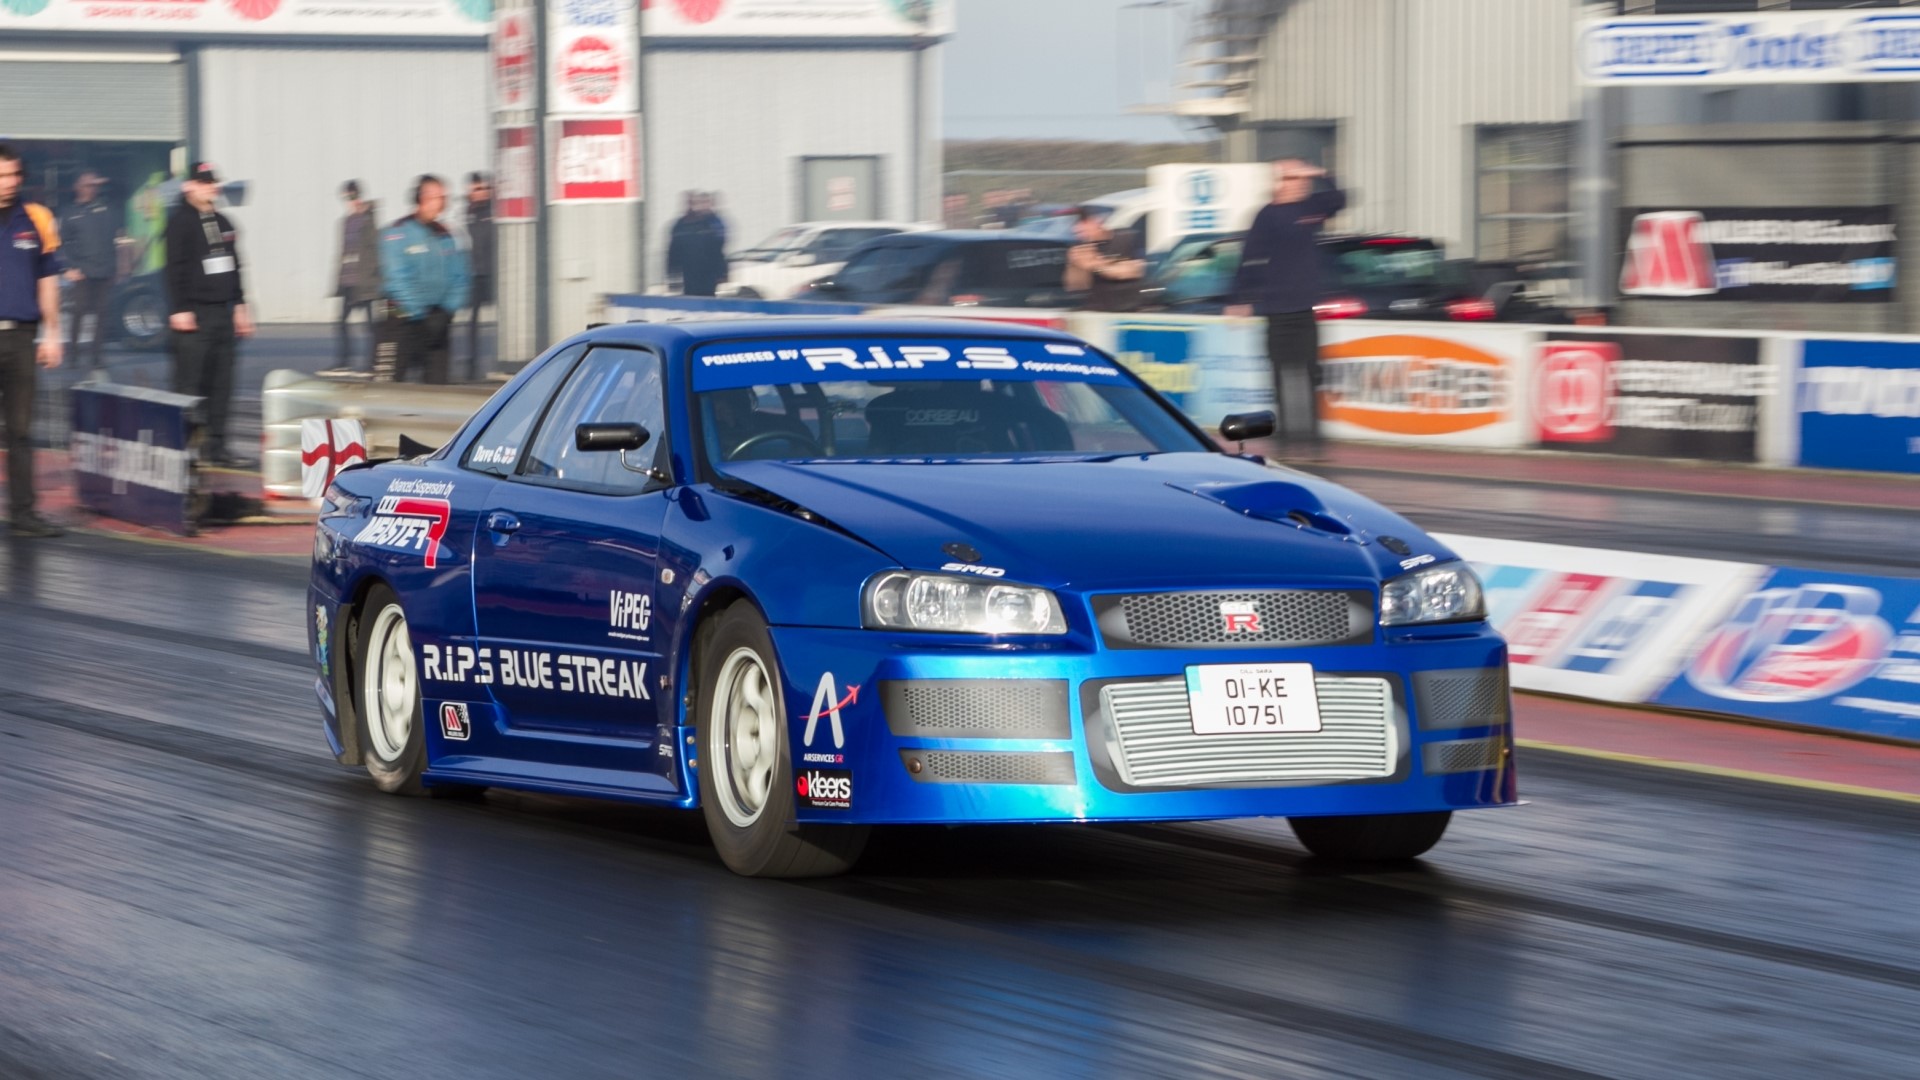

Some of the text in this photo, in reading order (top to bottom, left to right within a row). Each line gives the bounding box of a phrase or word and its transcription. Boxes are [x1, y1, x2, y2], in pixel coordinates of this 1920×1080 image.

[702, 350, 775, 366] POWERED
[776, 349, 799, 361] BY
[1022, 360, 1119, 376] ripsracing.com
[905, 408, 980, 423] CORBEAU
[472, 445, 492, 462] Dave
[387, 478, 456, 499] Advanced Suspension by
[940, 562, 1006, 577] SMD
[500, 649, 554, 689] BLUE
[557, 653, 651, 700] STREAK
[1225, 677, 1288, 699] 01-KE
[1225, 704, 1284, 726] 10751
[803, 753, 835, 763] AIRSERVICES
[807, 770, 851, 799] kleers
